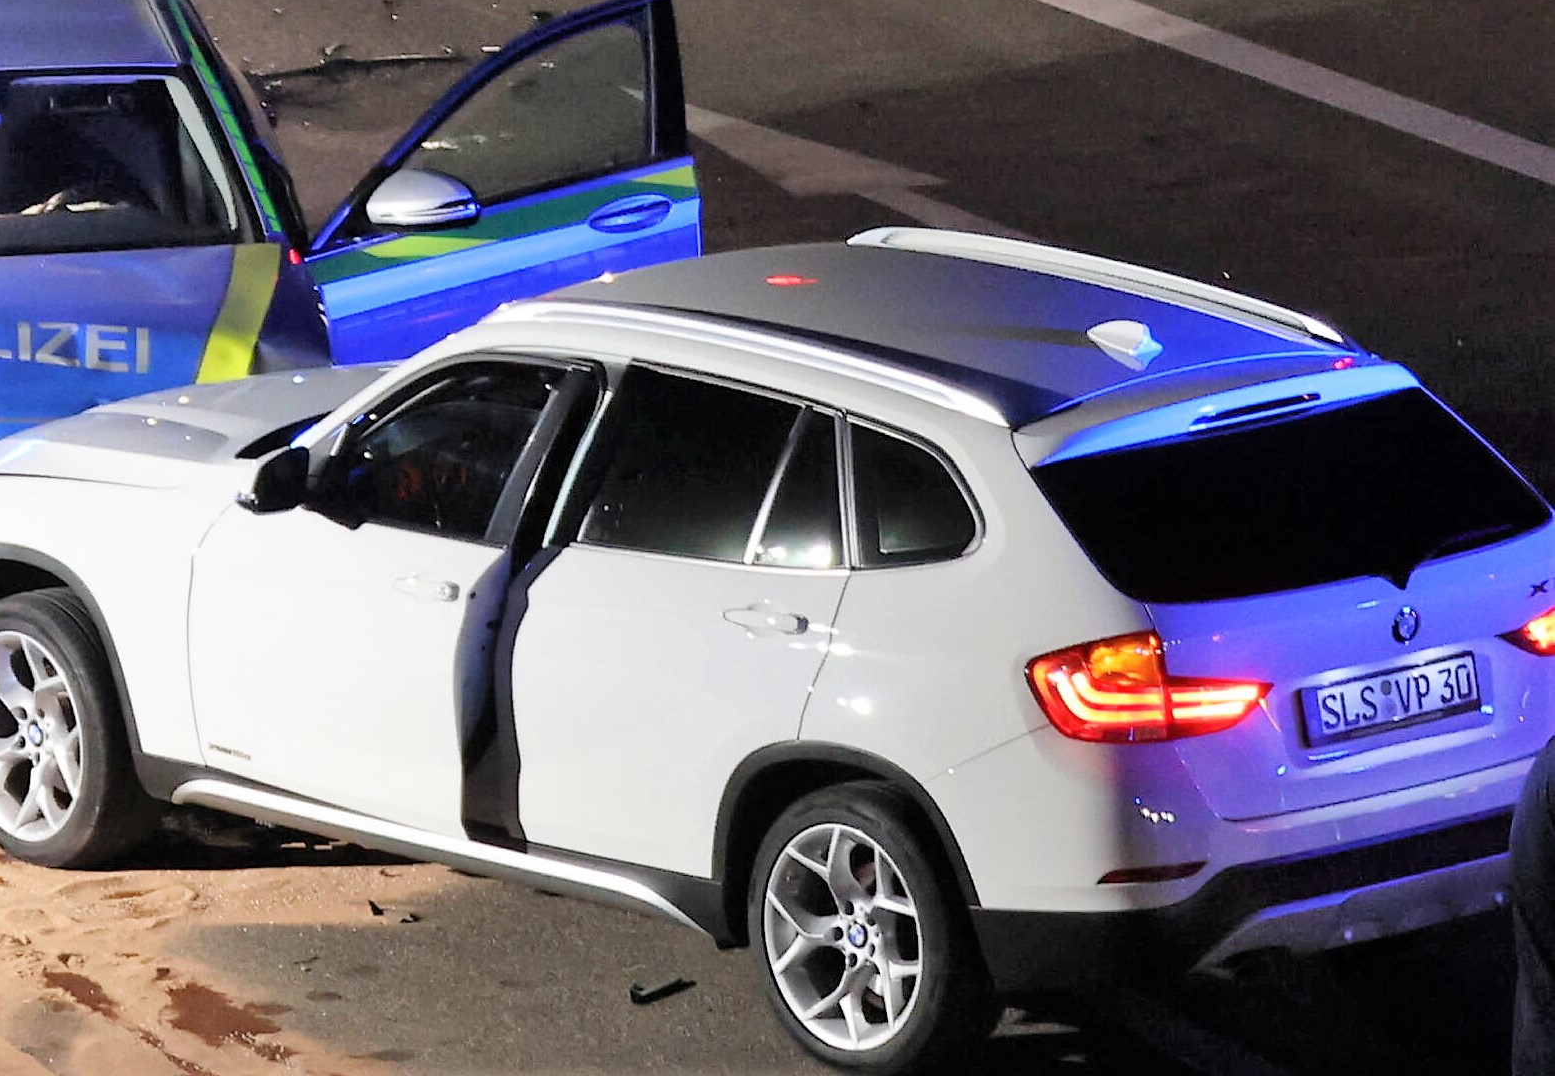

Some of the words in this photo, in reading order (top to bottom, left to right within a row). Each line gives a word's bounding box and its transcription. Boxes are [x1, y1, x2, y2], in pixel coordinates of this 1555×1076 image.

[1321, 685, 1378, 729] SLS
[1395, 674, 1430, 714] VP
[1438, 664, 1473, 704] 30
